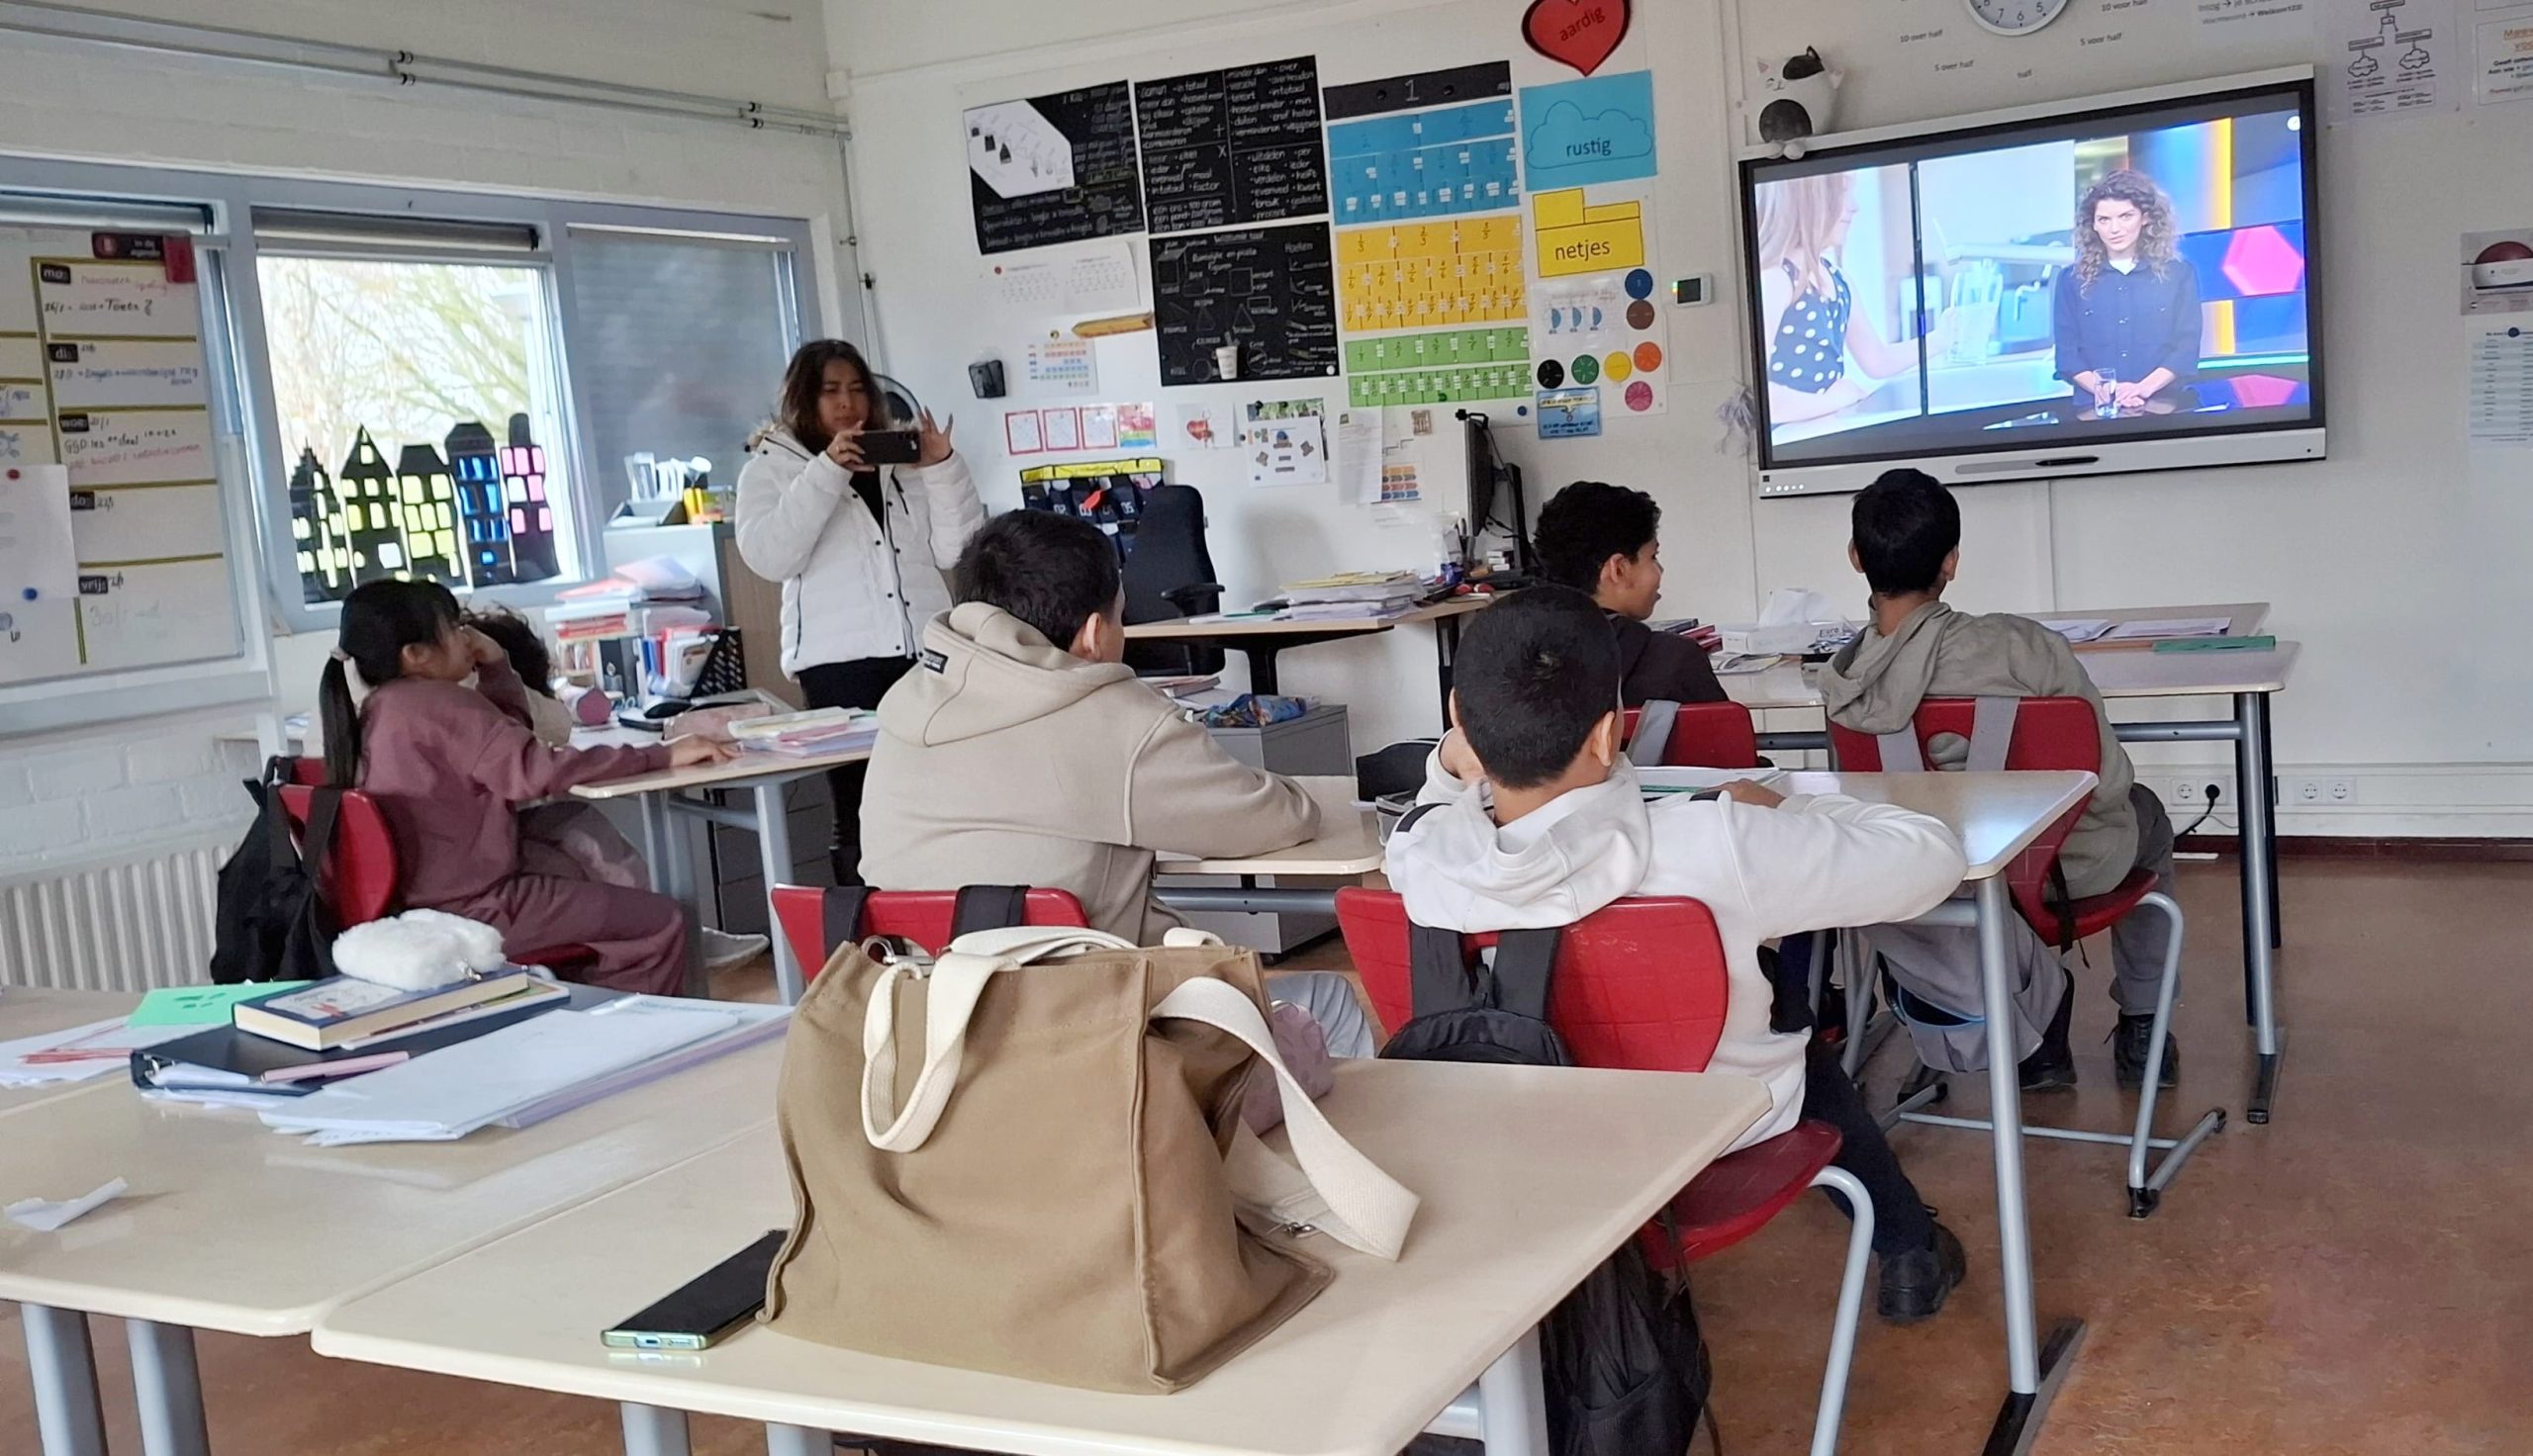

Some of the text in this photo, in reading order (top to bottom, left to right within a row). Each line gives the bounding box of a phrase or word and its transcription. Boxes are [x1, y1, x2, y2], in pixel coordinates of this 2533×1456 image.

[1998, 8, 2005, 18] 7
[2036, 3, 2043, 14] 5
[2017, 11, 2024, 22] 6
[1560, 6, 1605, 42] aardig
[1911, 33, 1927, 42] over
[1928, 29, 1943, 39] half
[2107, 33, 2122, 42] half
[1934, 59, 1974, 72] 5 over half
[2017, 69, 2032, 78] half
[1404, 79, 1420, 102] 1
[1566, 136, 1611, 157] rustig
[1554, 239, 1611, 262] netjes
